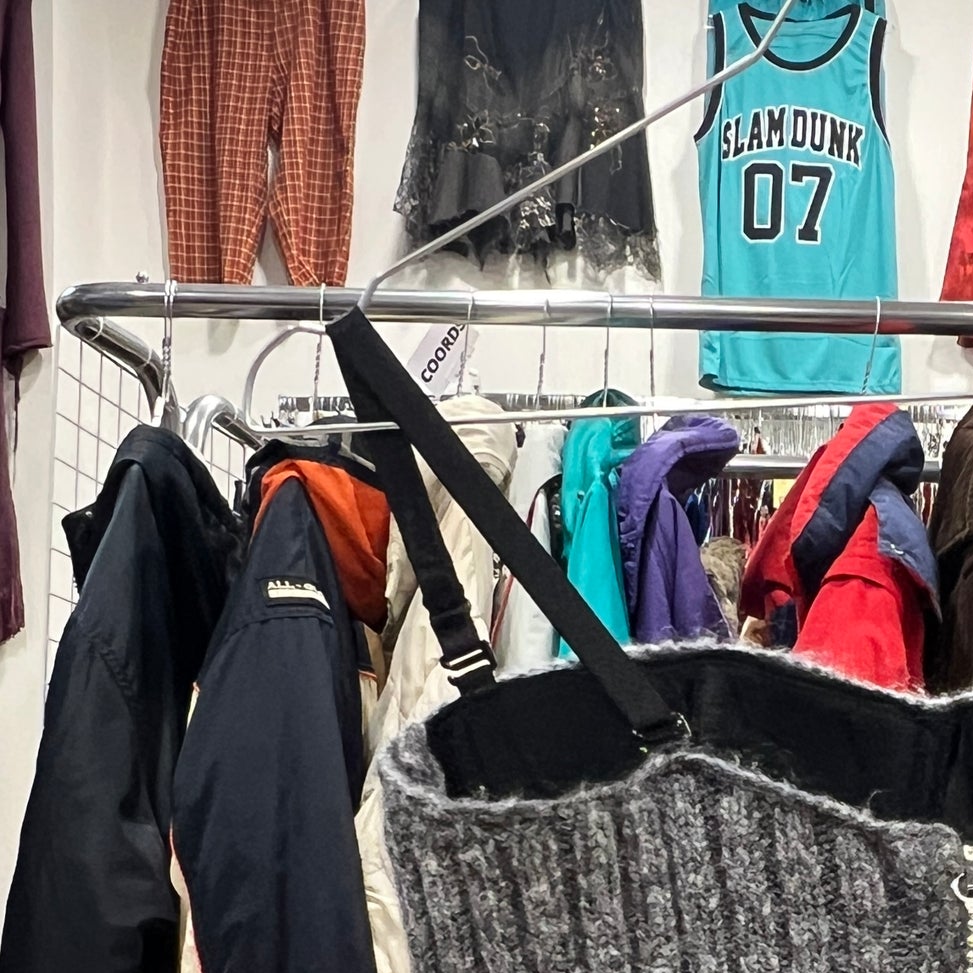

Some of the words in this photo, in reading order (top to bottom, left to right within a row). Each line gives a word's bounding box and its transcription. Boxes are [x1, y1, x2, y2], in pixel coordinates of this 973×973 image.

[721, 105, 787, 161] SLAM
[789, 105, 865, 170] DUNK
[742, 160, 834, 244] 07
